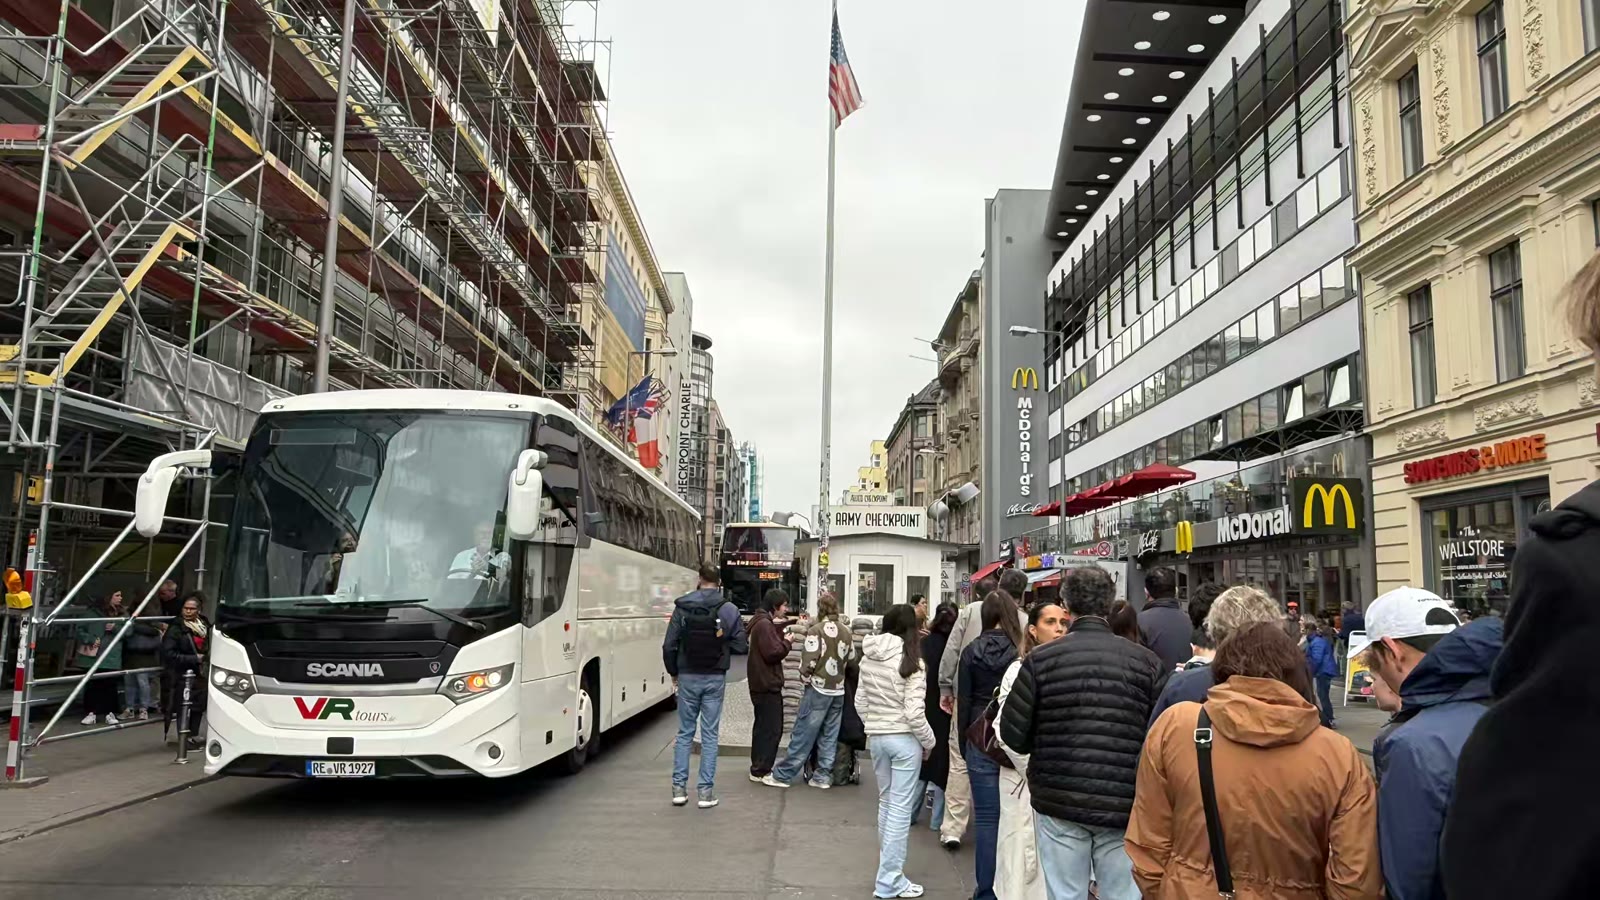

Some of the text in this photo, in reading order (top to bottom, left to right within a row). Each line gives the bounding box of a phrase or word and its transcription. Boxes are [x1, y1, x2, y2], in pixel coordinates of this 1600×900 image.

[680, 383, 692, 428] CHARLIE
[1017, 397, 1034, 496] McDonald's
[1403, 433, 1547, 484] SOUVENIRS & MORE
[835, 512, 861, 526] ARMY
[865, 512, 920, 528] CHECKPOINT
[1006, 503, 1042, 517] McCaf
[1217, 504, 1292, 544] McDonal
[1463, 525, 1476, 537] The
[1439, 540, 1505, 561] WALLSTORE
[306, 663, 384, 677] SCANIA
[293, 697, 355, 720] VR
[313, 762, 374, 774] RE VR 1927
